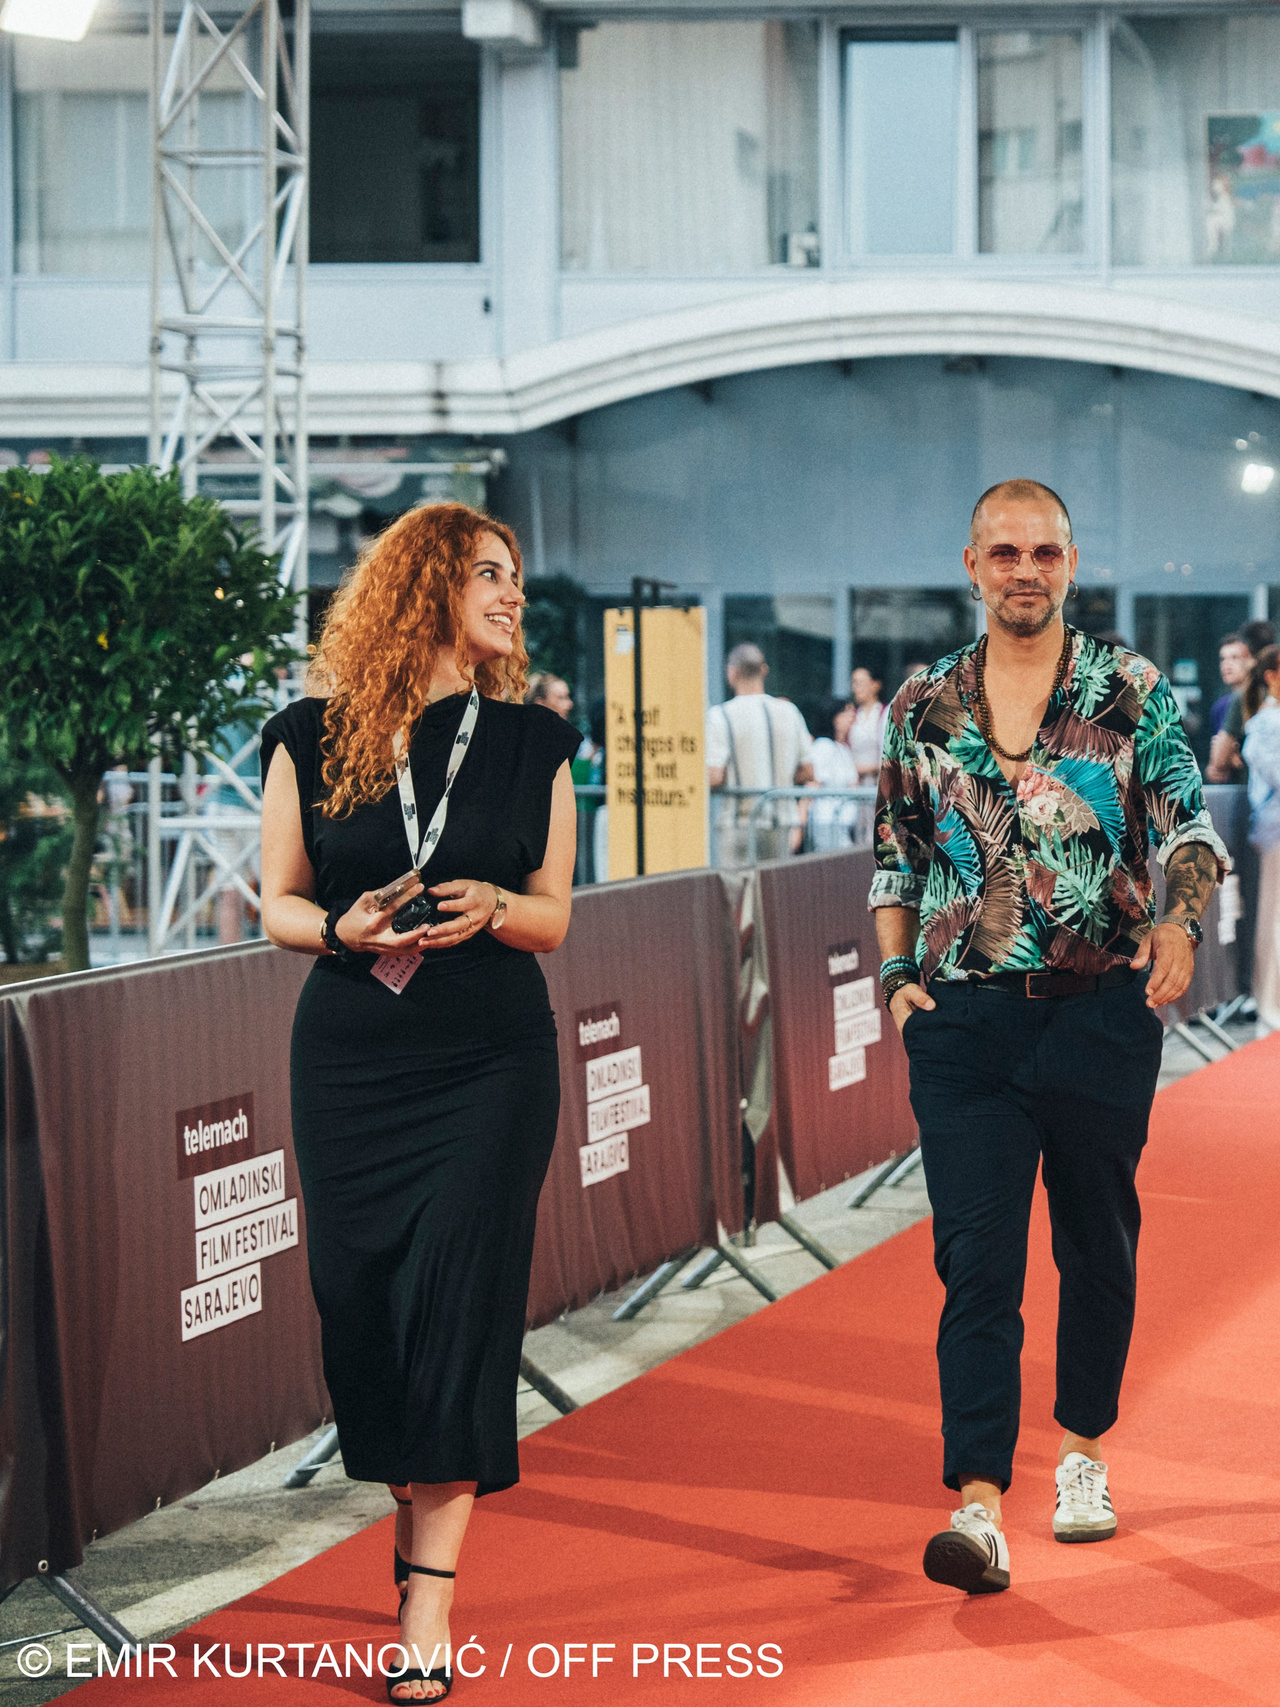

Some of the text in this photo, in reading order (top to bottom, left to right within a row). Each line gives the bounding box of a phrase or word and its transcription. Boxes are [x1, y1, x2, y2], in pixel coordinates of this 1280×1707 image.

[184, 1108, 249, 1156] telemach
[199, 1161, 283, 1215] OMLADINSKI
[201, 1210, 295, 1270] FILM FESTIVAL
[184, 1273, 260, 1330] SARAJEVO
